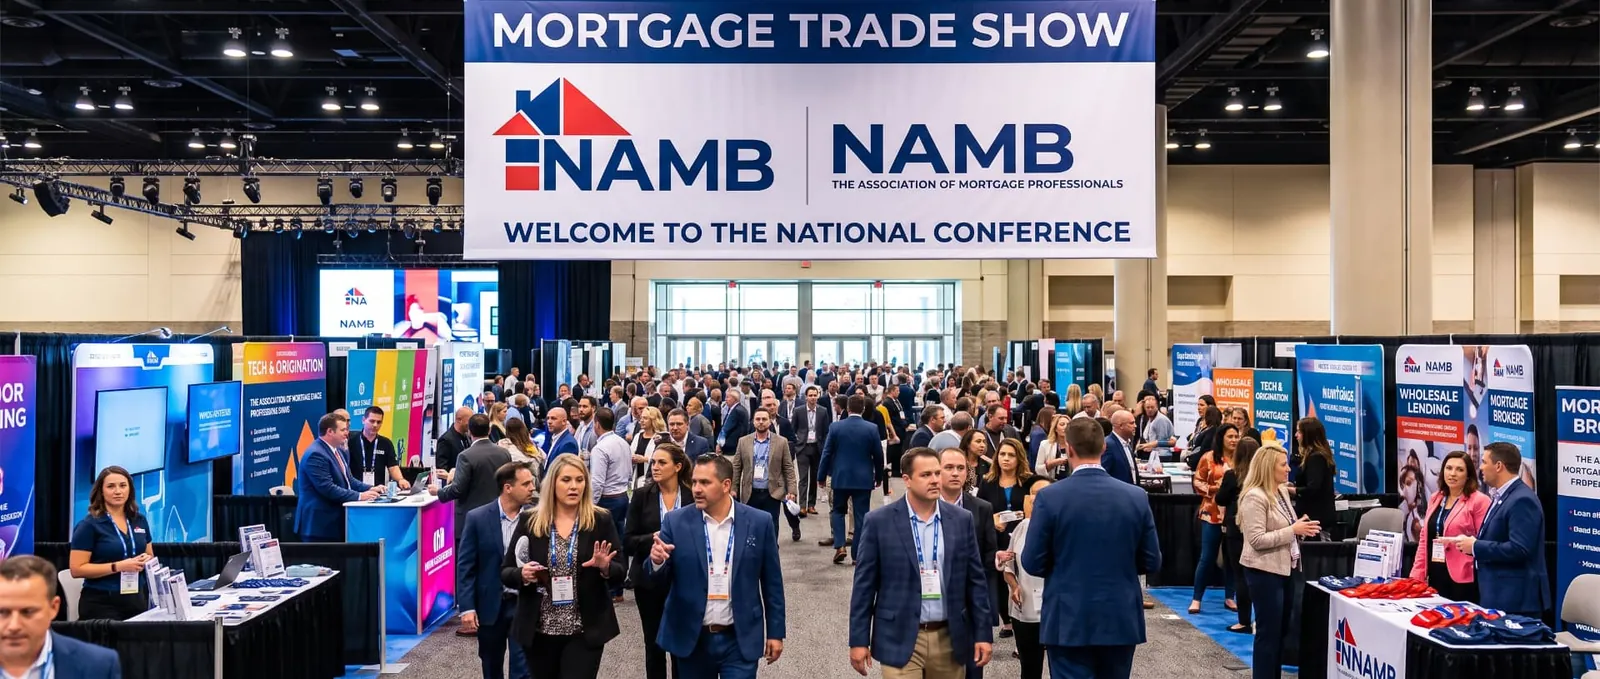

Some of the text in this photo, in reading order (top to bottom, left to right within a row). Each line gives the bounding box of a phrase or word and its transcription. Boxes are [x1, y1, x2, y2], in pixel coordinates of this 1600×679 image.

[494, 12, 1129, 48] MORTGAGE TRADE SHOW
[833, 124, 1074, 173] NAMB
[543, 139, 774, 191] NAMB
[832, 180, 1123, 189] THE ASSOCIATION OF MORTGAGE PROFESSIONALS
[504, 222, 1131, 244] WELCOME TO THE NATIONAL CONFERENCE
[340, 320, 375, 329] NAMB
[248, 358, 324, 376] TECH & ORIGINATION
[1425, 361, 1453, 372] NAMB
[1506, 364, 1524, 376] NAMB
[1215, 377, 1252, 387] WHOLESALE
[1260, 381, 1283, 392] TECH &
[0, 383, 24, 403] OR
[1216, 387, 1250, 399] LENDING
[1255, 392, 1289, 402] ORIGINATION
[1399, 388, 1459, 402] WHOLESALE
[1490, 394, 1528, 410] MORTGAGE
[1561, 398, 1600, 414] MOR
[1256, 410, 1290, 421] MORTGAGE
[1407, 402, 1450, 416] LENDING
[1493, 409, 1525, 425] BROKERS
[1573, 418, 1600, 434] BR
[1575, 455, 1600, 465] THE A
[1562, 465, 1600, 477] MORTGA
[1573, 509, 1591, 519] Loan
